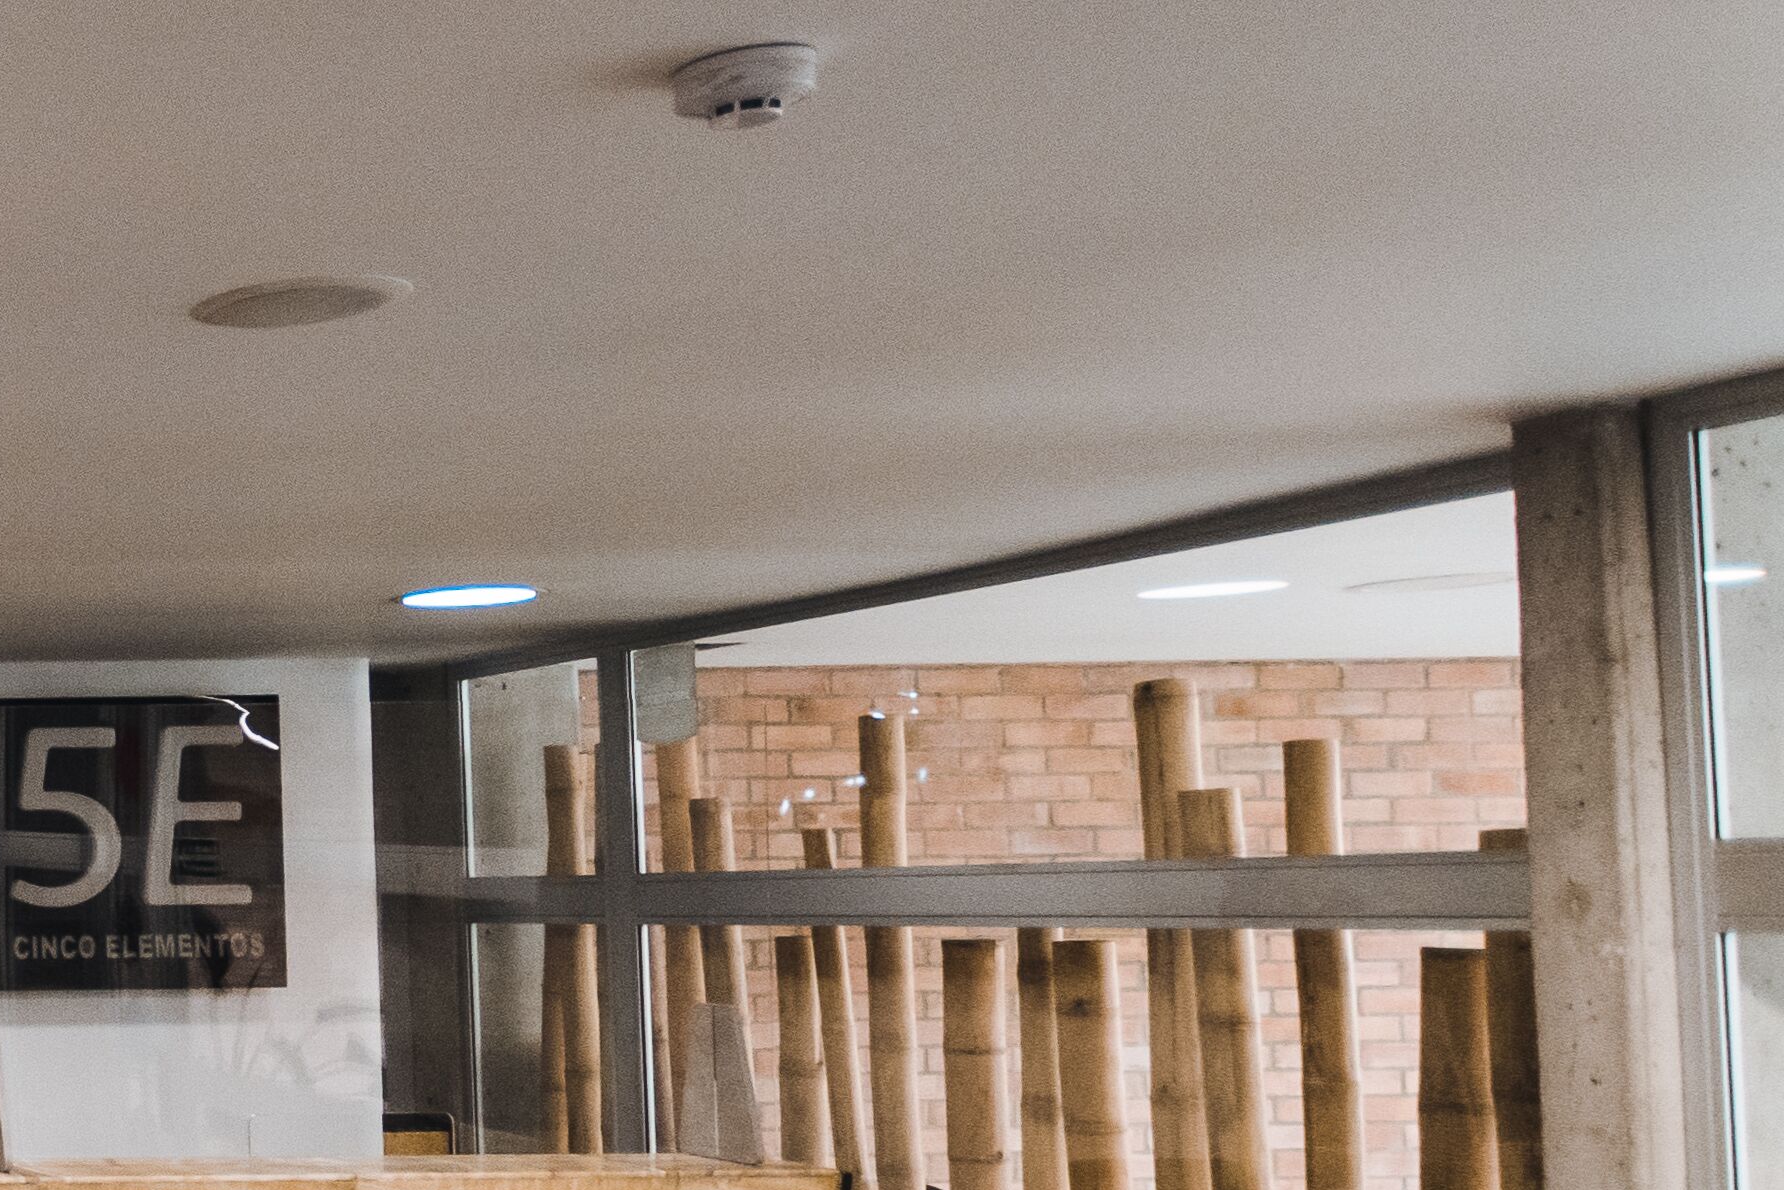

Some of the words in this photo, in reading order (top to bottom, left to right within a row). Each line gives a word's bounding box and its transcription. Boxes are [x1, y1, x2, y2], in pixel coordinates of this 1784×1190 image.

[11, 725, 253, 907] 5E
[15, 935, 96, 960] CINCO
[106, 932, 265, 959] ELEMENTOS
